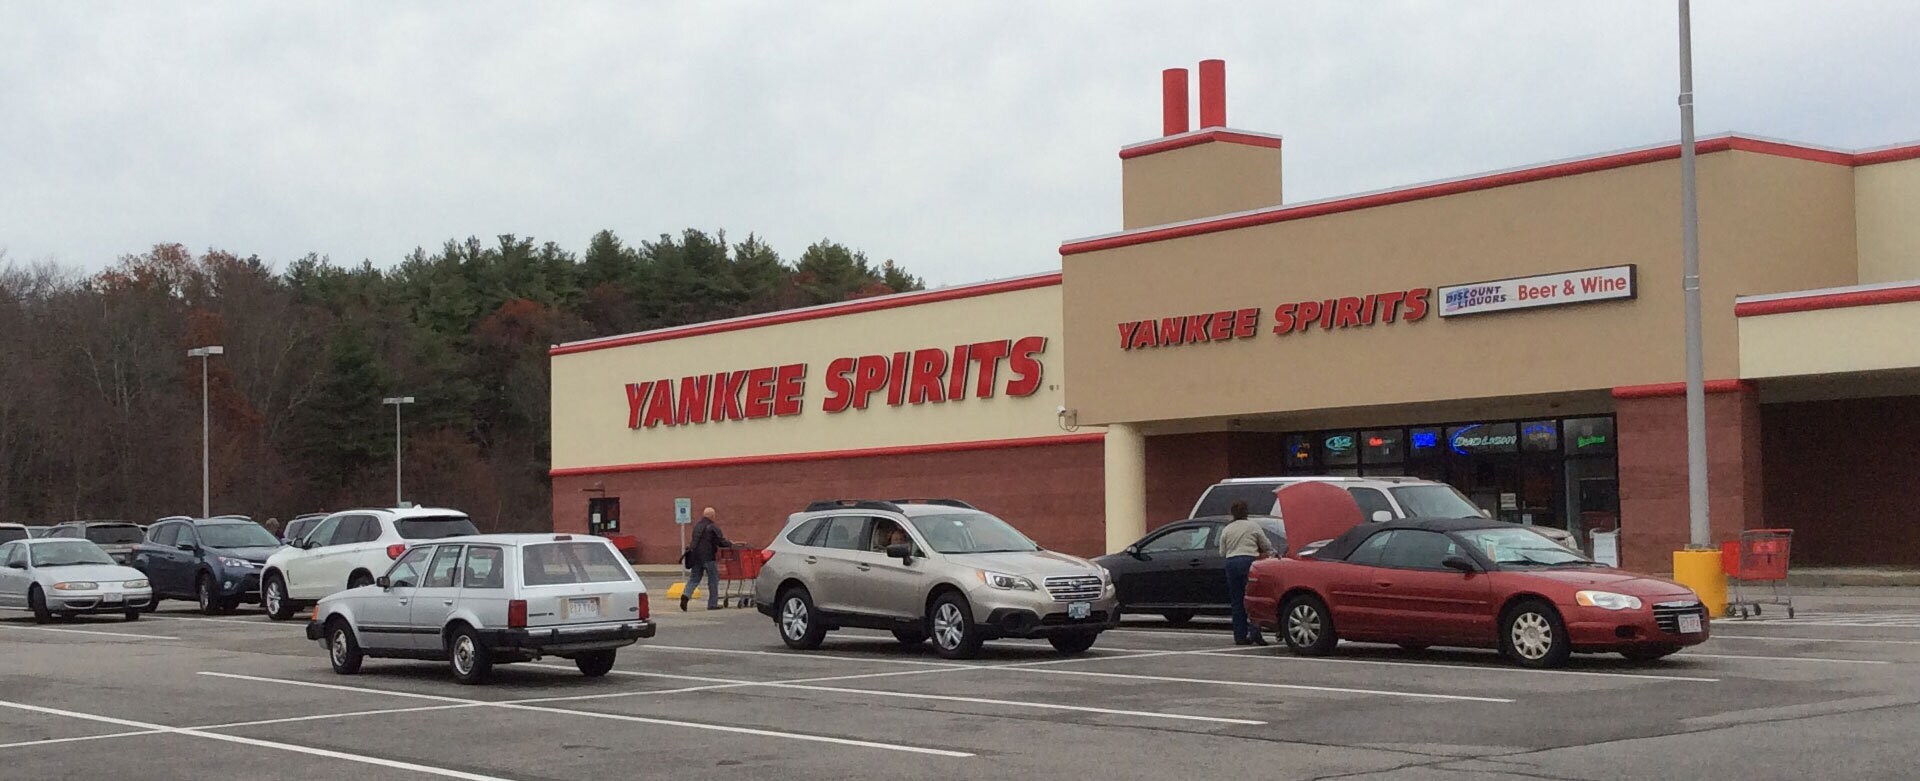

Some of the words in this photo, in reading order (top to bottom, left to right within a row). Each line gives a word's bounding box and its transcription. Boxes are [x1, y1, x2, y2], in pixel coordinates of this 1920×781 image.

[1445, 286, 1502, 304] DISCOUNT
[1518, 284, 1558, 301] Beer
[1563, 280, 1575, 296] &
[1581, 276, 1627, 294] Wine
[1457, 294, 1507, 309] LIQUORS
[1118, 308, 1259, 351] YANKEE
[1273, 287, 1431, 335] SPIRITS
[625, 364, 808, 429] YANKEE
[822, 336, 1048, 413] SPIRITS
